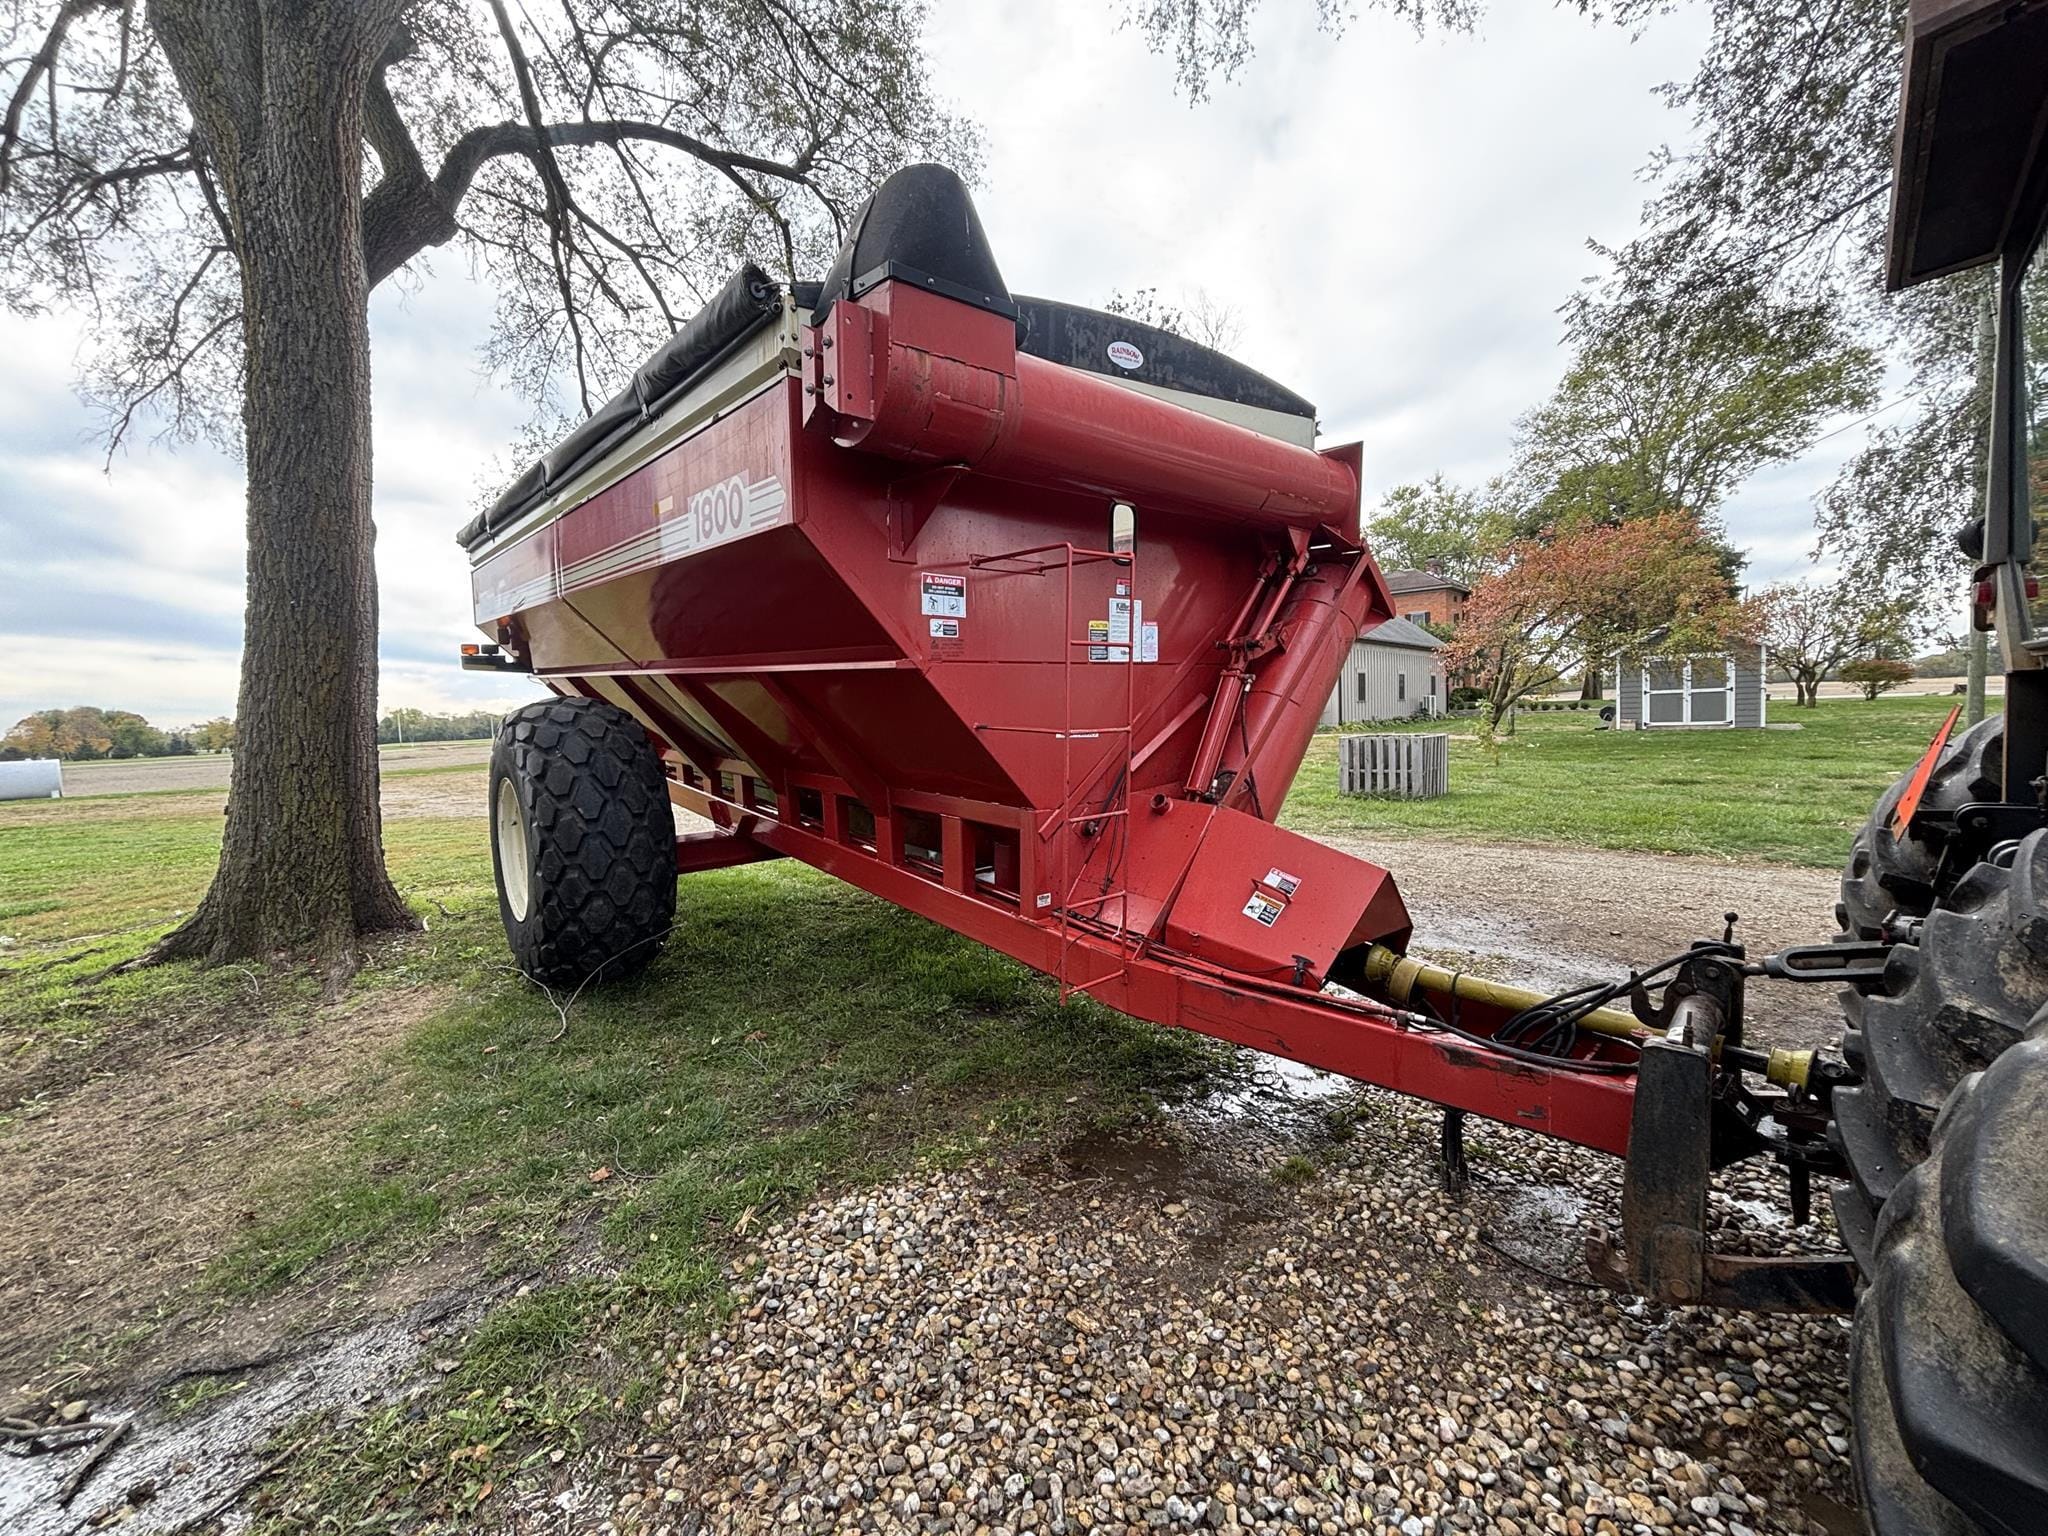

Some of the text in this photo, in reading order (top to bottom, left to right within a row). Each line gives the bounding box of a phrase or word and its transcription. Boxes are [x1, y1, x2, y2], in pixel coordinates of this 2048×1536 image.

[1111, 346, 1140, 359] RAINBOW
[693, 482, 743, 543] 1800
[934, 576, 962, 586] DANGER
